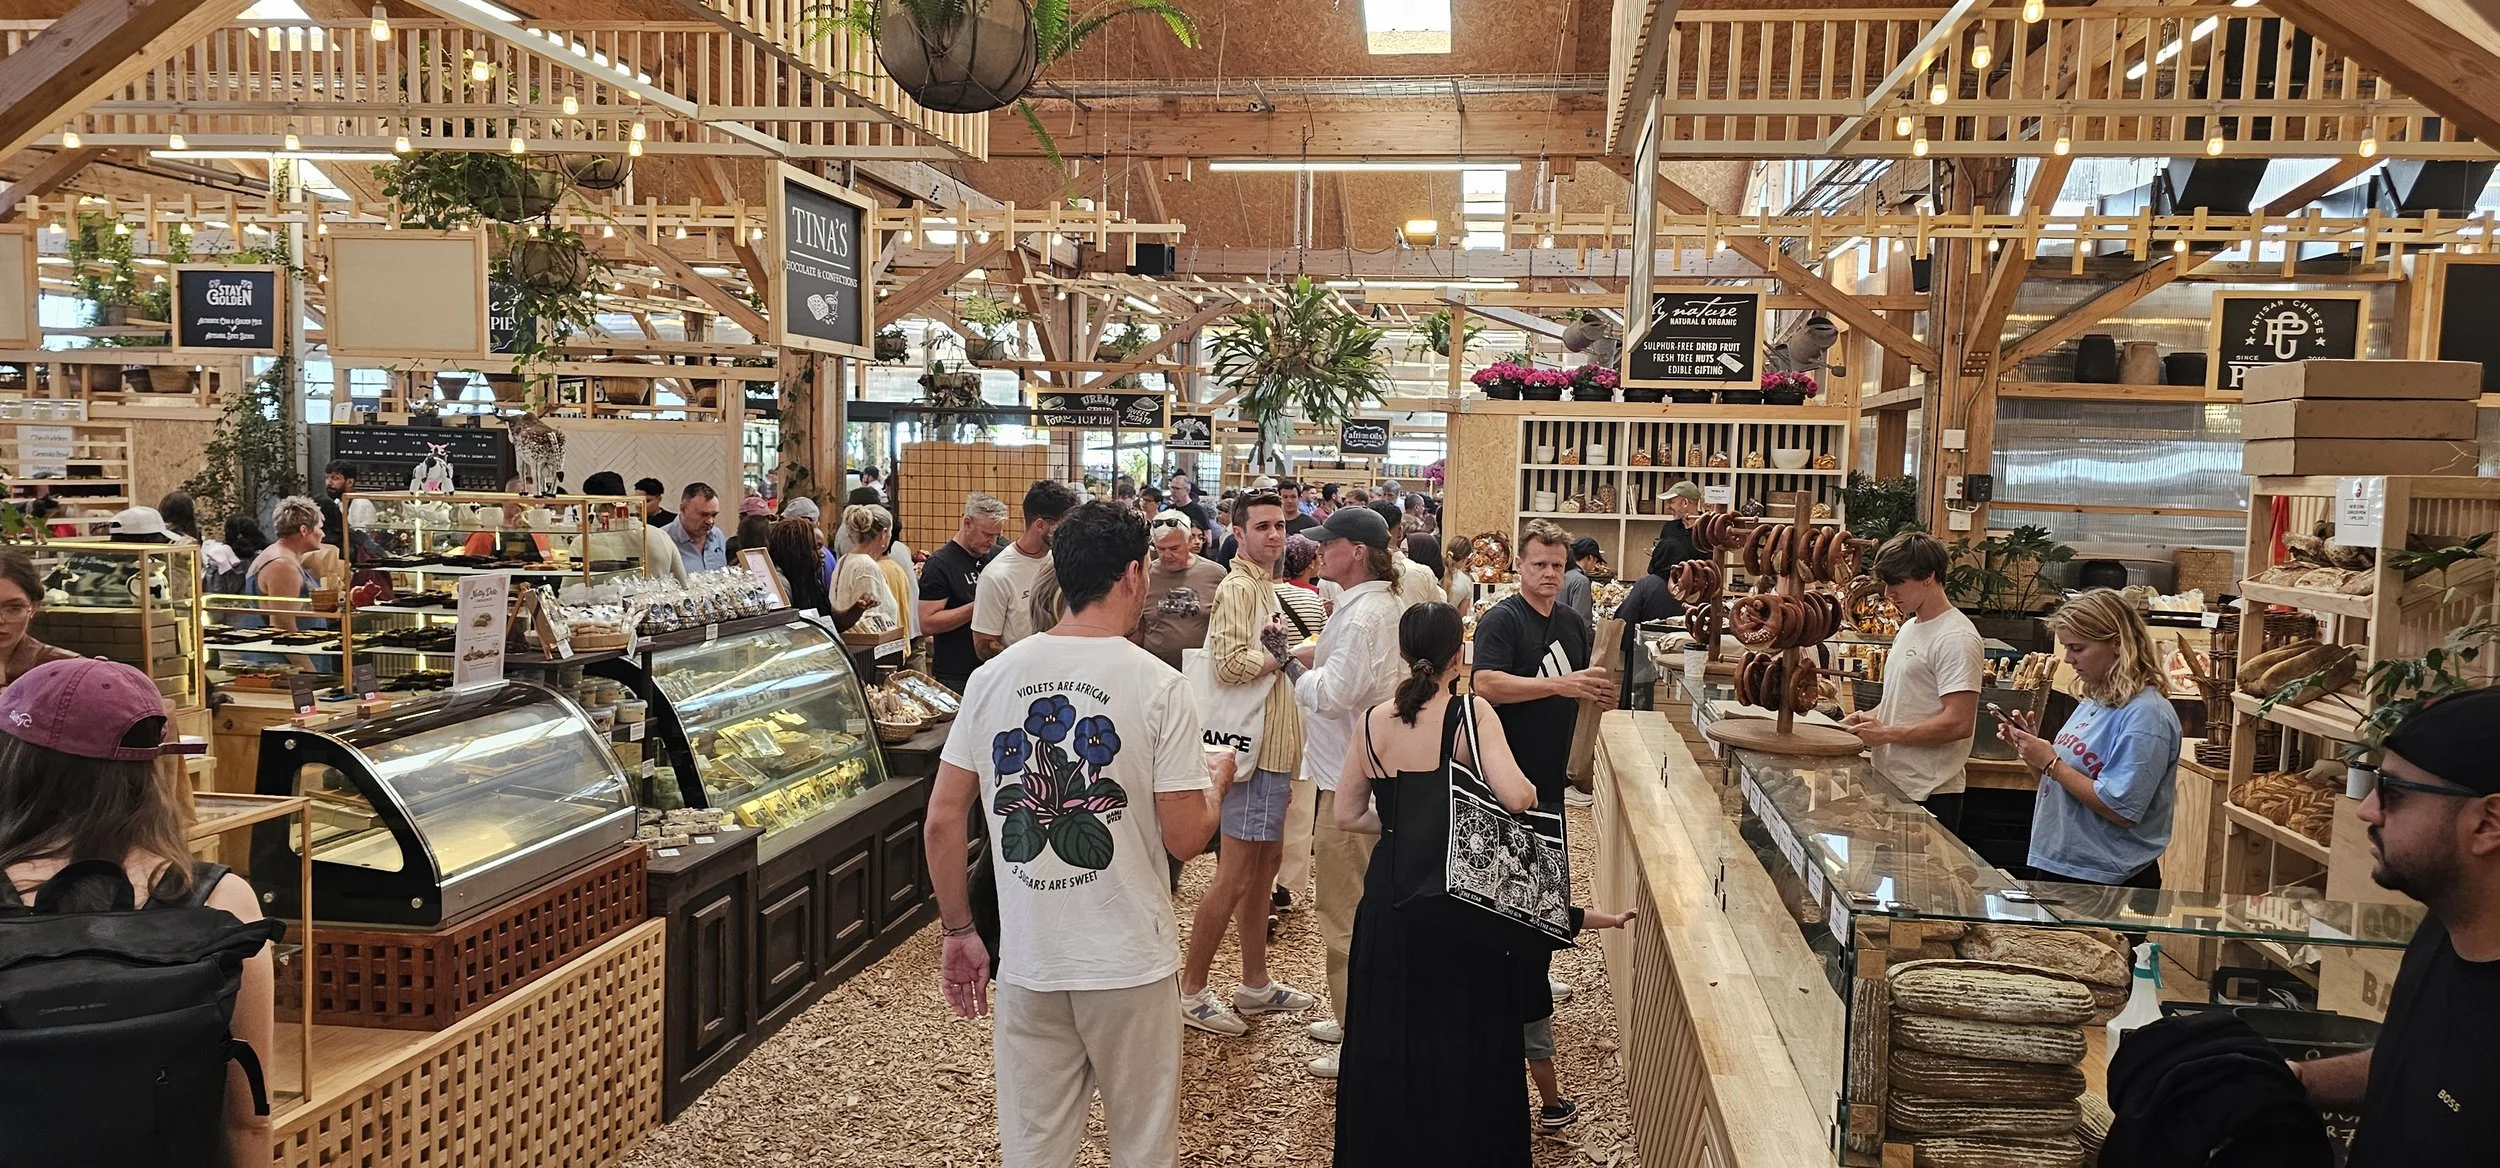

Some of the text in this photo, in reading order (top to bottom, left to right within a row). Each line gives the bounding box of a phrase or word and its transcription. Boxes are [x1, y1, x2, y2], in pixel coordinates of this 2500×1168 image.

[792, 206, 848, 258] TINA'S
[786, 258, 858, 288] HOCOLATE & CONFECTIONS
[206, 289, 252, 306] GOLDEN
[218, 285, 242, 296] STAY
[1670, 318, 1738, 326] NATURAL & ORGANIC
[2249, 300, 2324, 335] ARTISAN CHEESE
[1643, 341, 1741, 352] SULPHUR-FREE DRIED FRUIT
[1652, 353, 1715, 364] FRESH TREE NUTS
[1668, 366, 1723, 376] EDIBLE GIFTING
[2228, 365, 2248, 388] P
[1080, 395, 1119, 407] URBAN
[1016, 681, 1111, 705] VIOLETS ARE AFRICAN
[1011, 865, 1098, 891] 3 SUGARS ARE SWEET
[2437, 1089, 2461, 1113] BOSS
